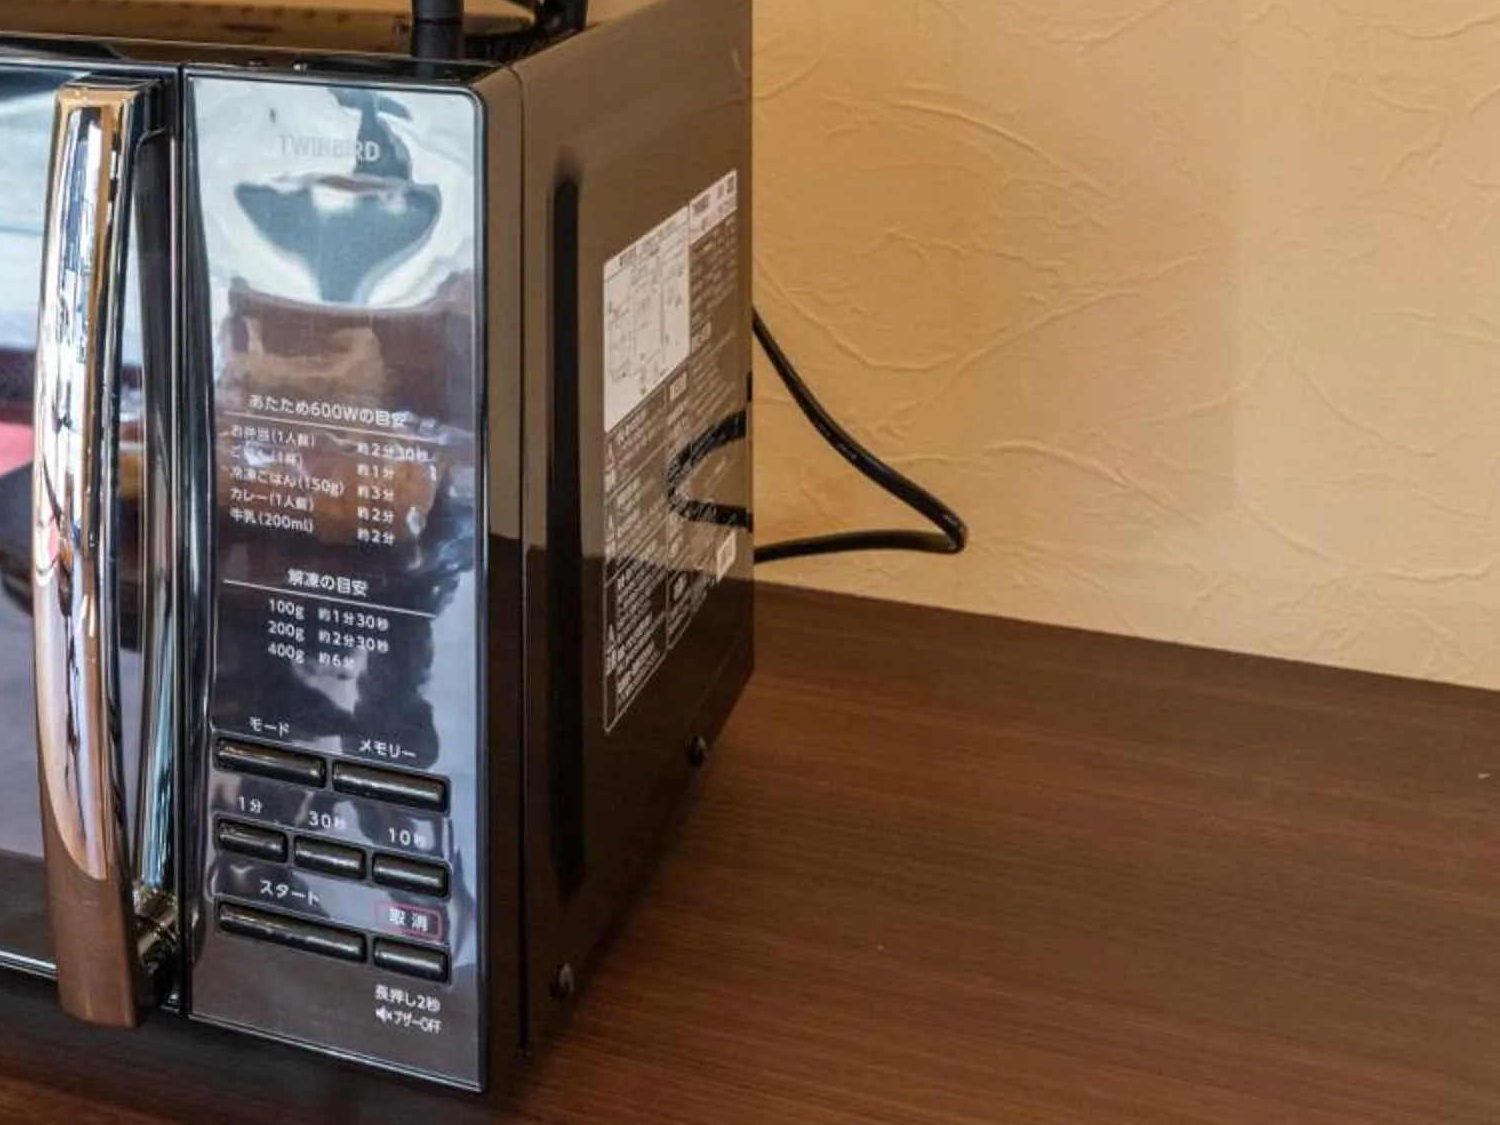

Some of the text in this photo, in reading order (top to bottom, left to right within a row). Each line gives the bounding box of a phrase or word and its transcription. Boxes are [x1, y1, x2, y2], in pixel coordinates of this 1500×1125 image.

[287, 568, 369, 598] 解凍の目安
[250, 717, 290, 735] モード
[359, 738, 417, 759] メモリー
[238, 796, 263, 814] 1分
[259, 880, 321, 906] スタート
[389, 907, 430, 933] 取消
